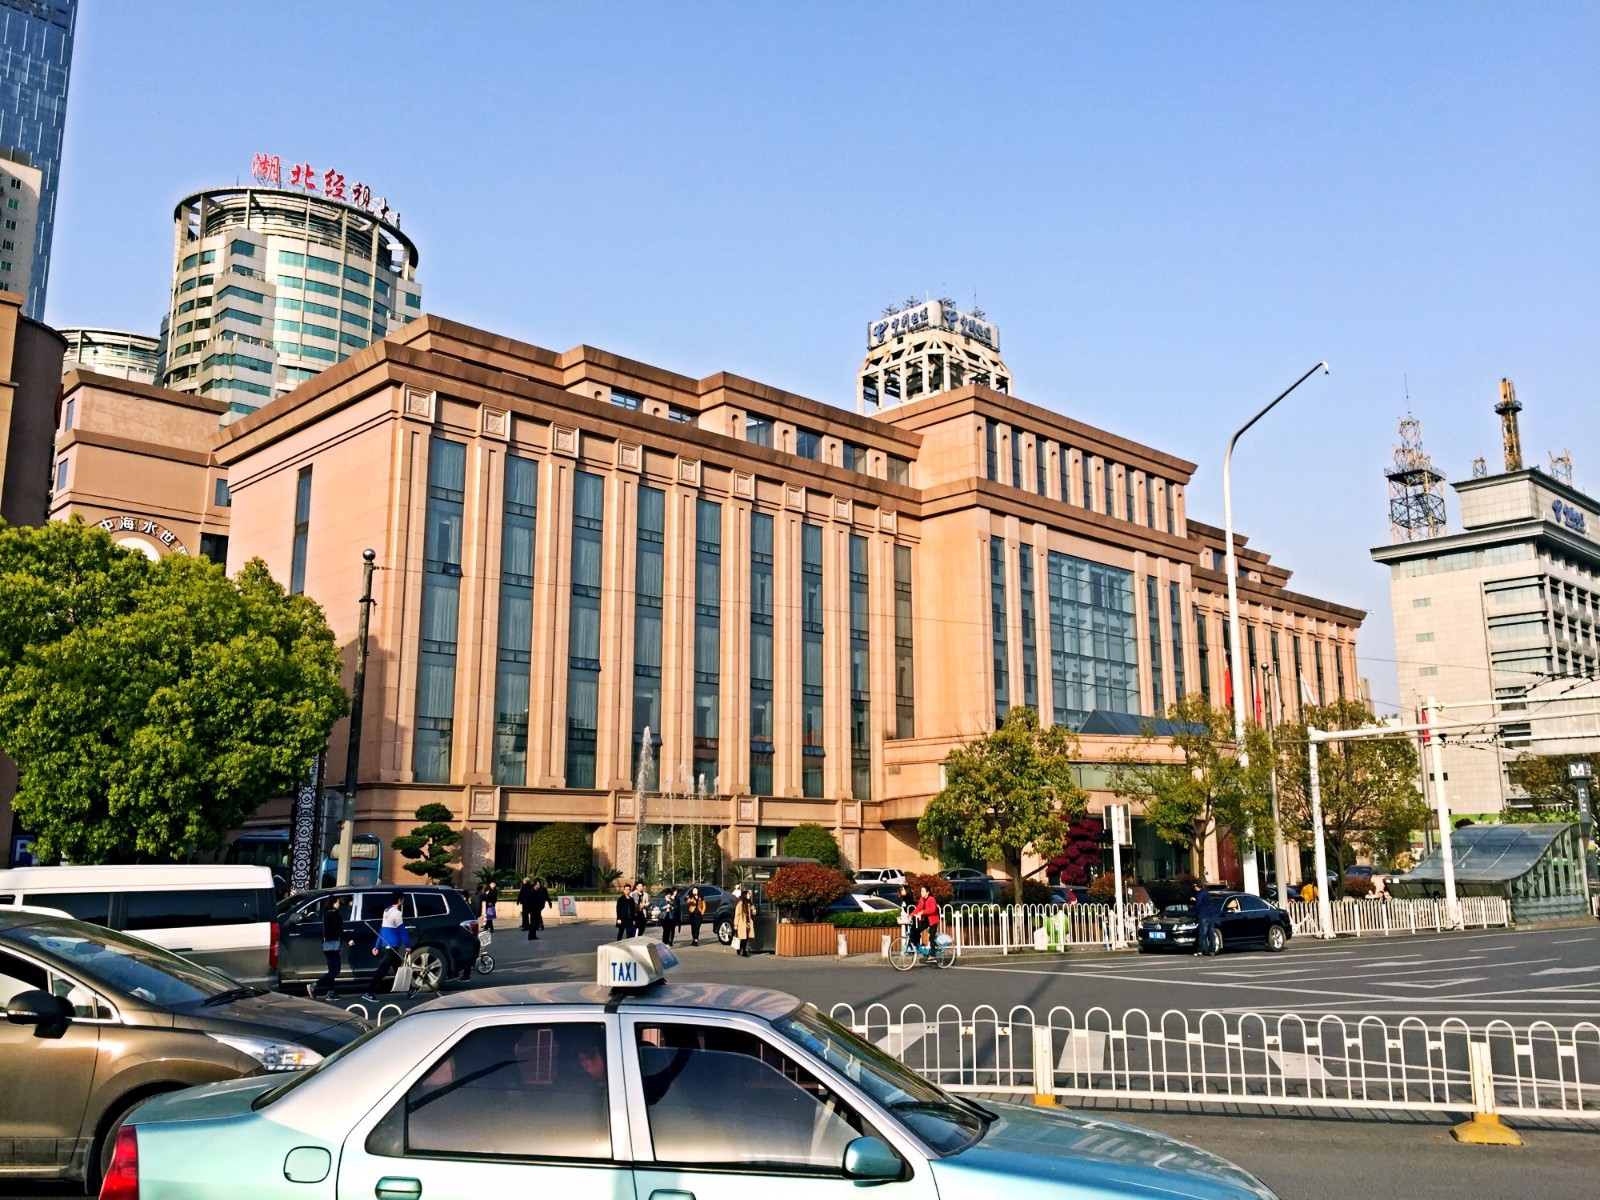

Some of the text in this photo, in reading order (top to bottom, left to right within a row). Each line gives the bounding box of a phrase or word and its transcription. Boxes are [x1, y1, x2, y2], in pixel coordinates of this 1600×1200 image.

[252, 152, 400, 230] 湖北经视大
[561, 897, 572, 910] P
[611, 962, 637, 981] TAXI
